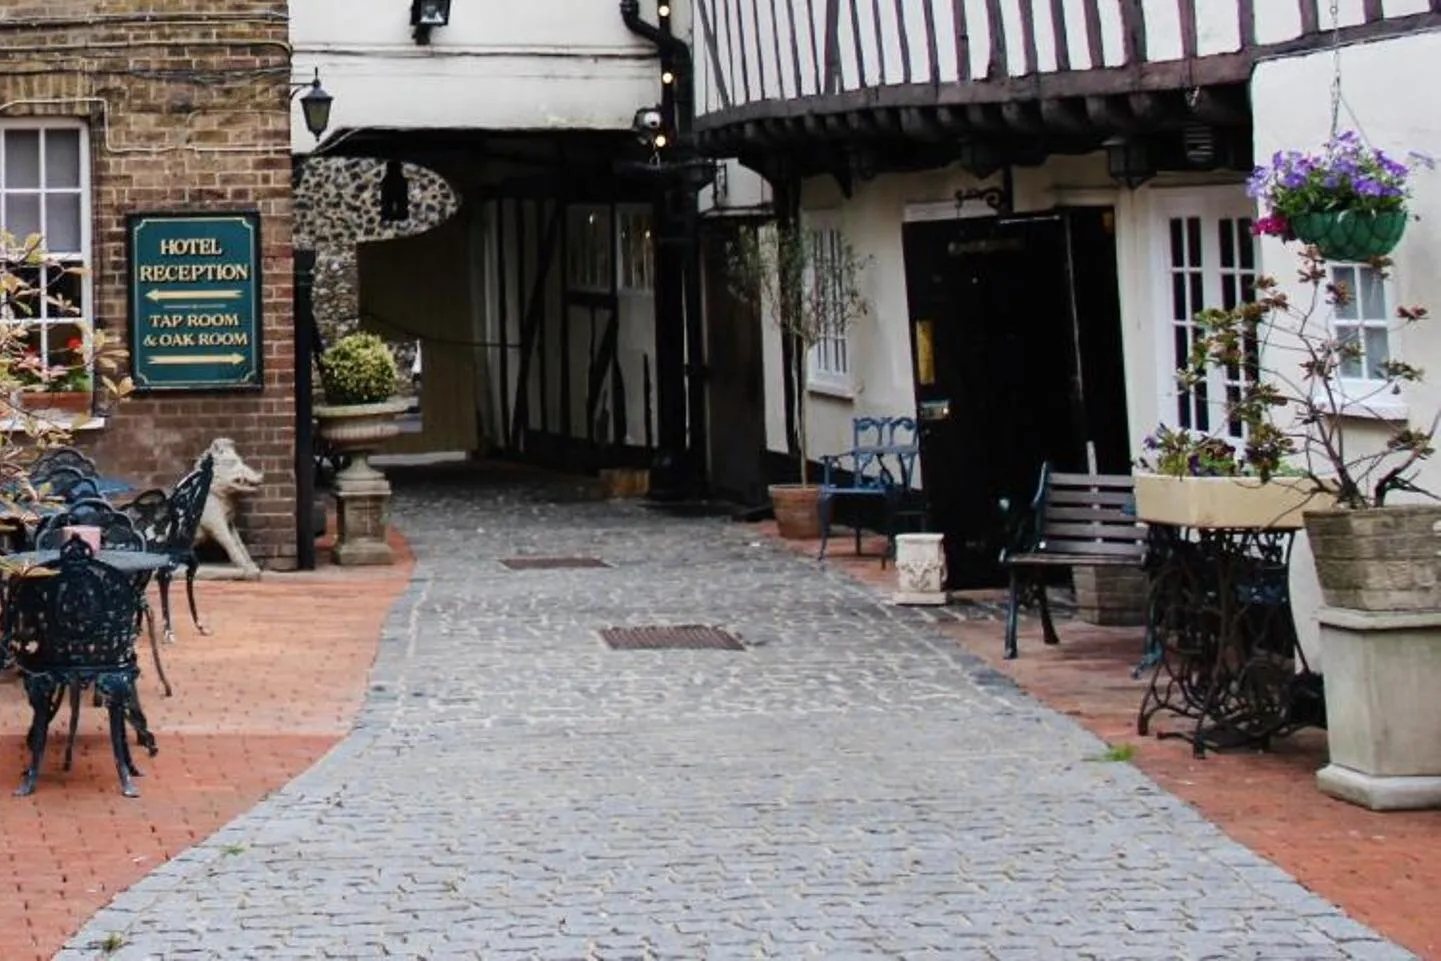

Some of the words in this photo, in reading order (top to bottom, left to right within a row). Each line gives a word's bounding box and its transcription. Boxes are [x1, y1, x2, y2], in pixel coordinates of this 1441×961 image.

[160, 237, 222, 255] HOTEL
[140, 263, 249, 282] RECEPTION
[150, 313, 183, 328] TAP
[187, 312, 239, 327] ROOM
[143, 334, 159, 346] &
[160, 333, 195, 346] OAK
[198, 332, 249, 346] ROOM
